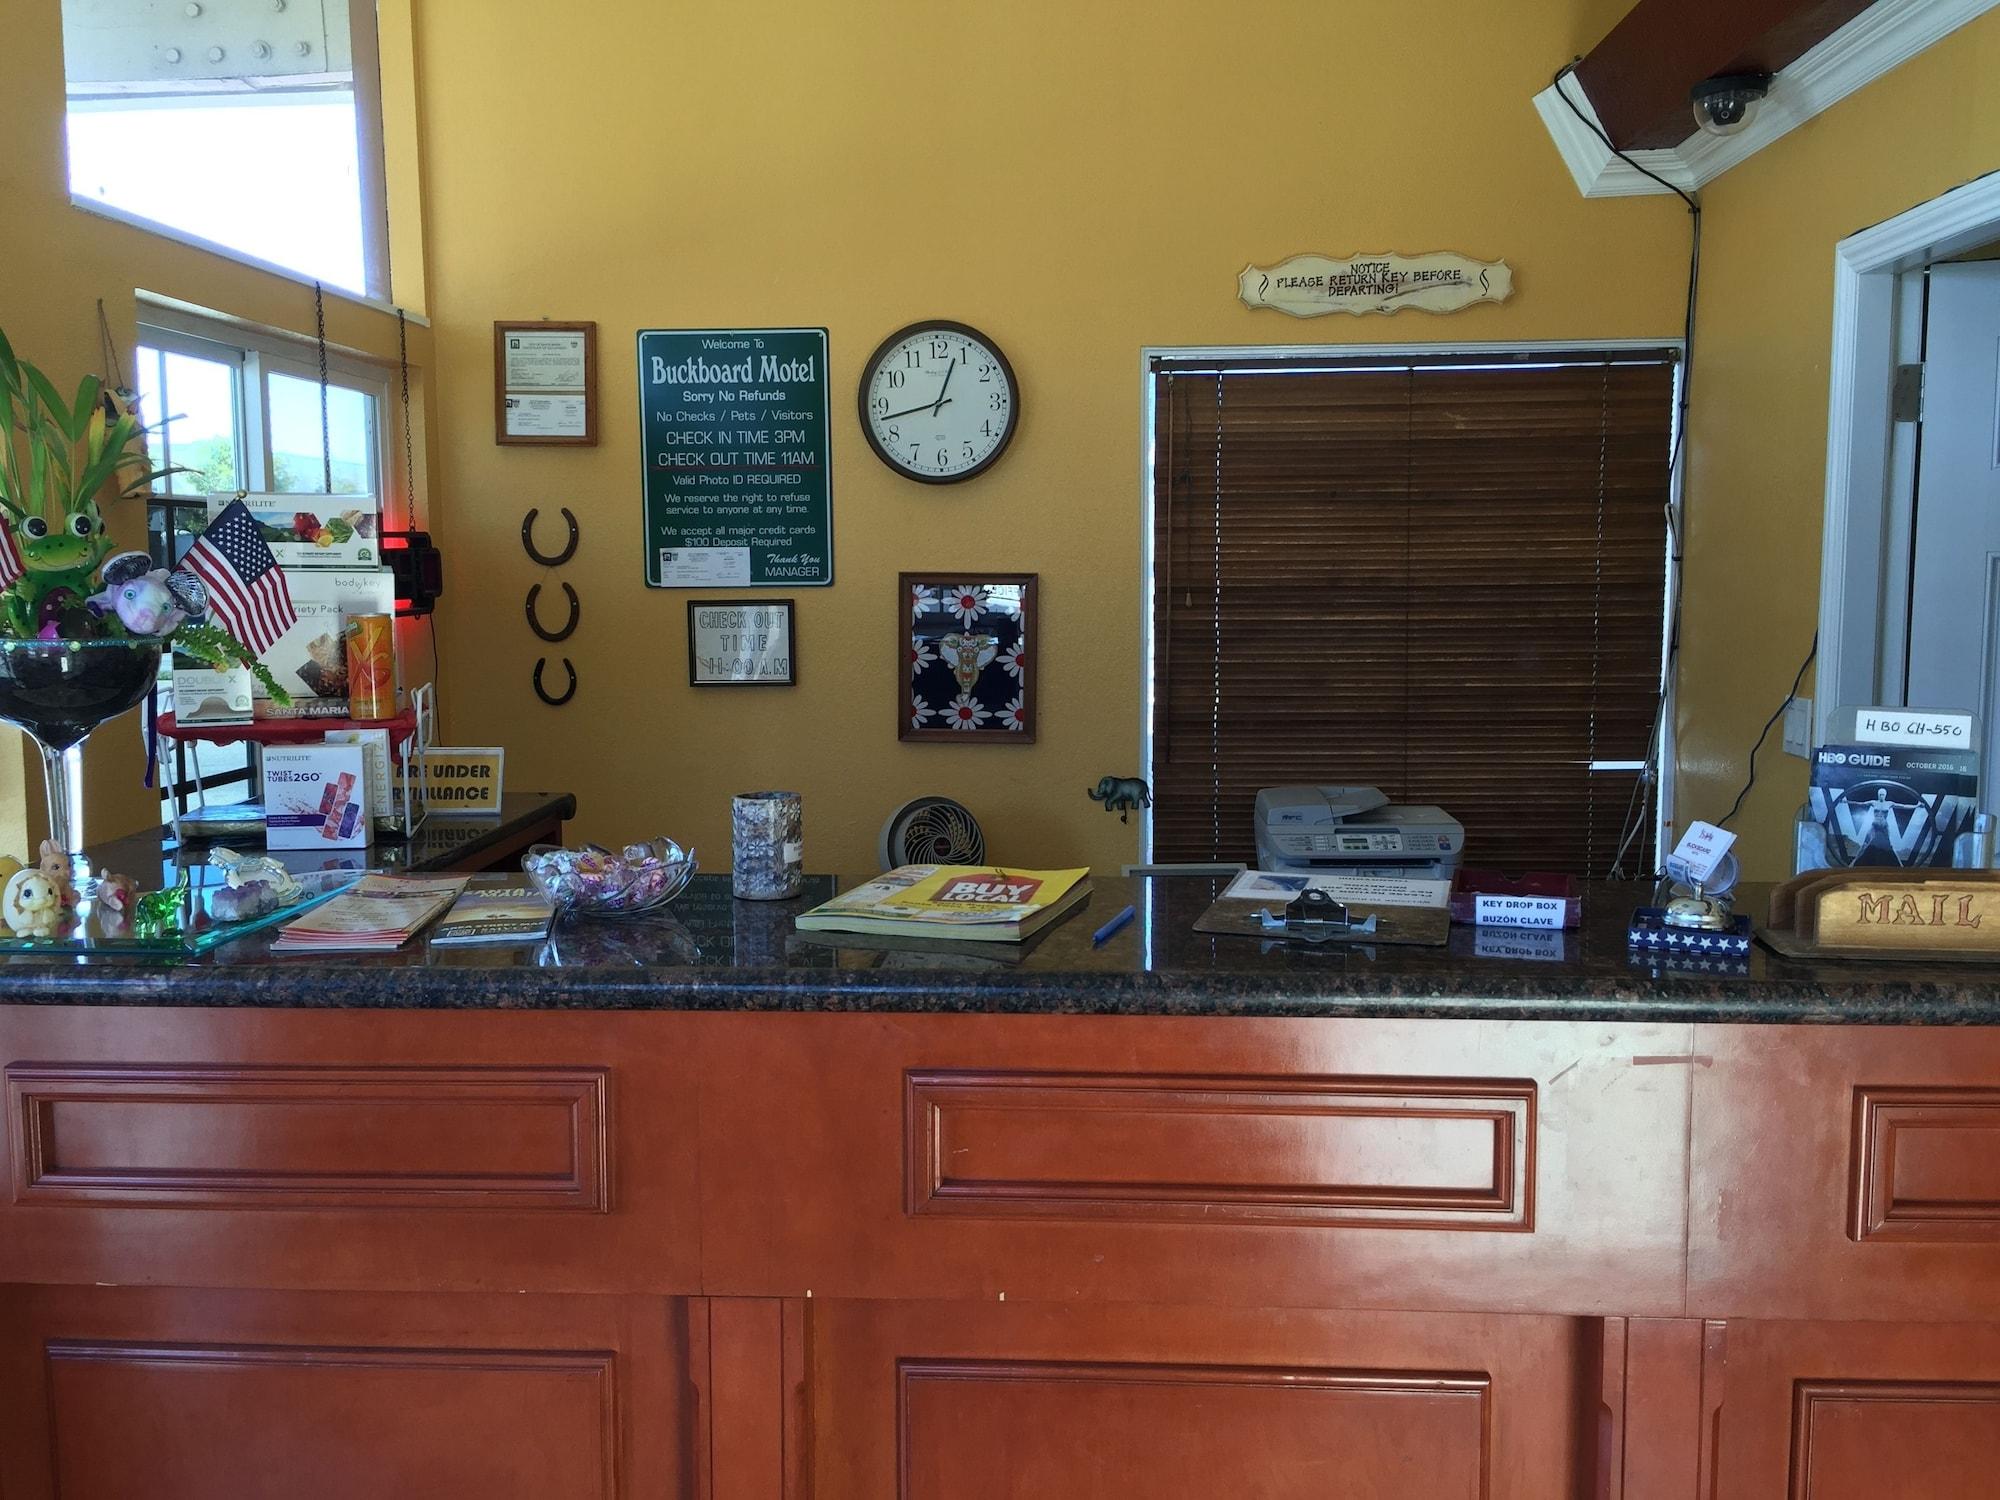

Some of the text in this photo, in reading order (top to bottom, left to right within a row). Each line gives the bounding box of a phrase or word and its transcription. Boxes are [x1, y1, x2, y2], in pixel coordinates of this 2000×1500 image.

[1350, 263, 1390, 273] NOTICE
[1277, 270, 1460, 288] PLEASE RETURN KEY BEFORE
[1328, 284, 1399, 296] DEPARTING!
[702, 339, 764, 349] Welcome To
[930, 341, 948, 359] 12
[906, 351, 920, 368] 11
[960, 348, 968, 365] 1
[652, 355, 815, 384] Buckboard Motel
[979, 365, 990, 382] 2
[888, 370, 904, 388] 10
[683, 390, 785, 403] Sorry No Refunds
[990, 393, 1000, 411] 3
[878, 397, 889, 415] 9
[657, 412, 672, 421] No
[676, 411, 715, 421] Checks
[731, 411, 756, 421] Pets
[771, 410, 813, 420] Visitors
[889, 425, 900, 442] 8
[980, 420, 992, 436] 4
[666, 430, 805, 444] CHECK IN TIME 3PM
[910, 443, 920, 461] 7
[962, 441, 973, 458] 5
[658, 452, 814, 466] CHECK OUT TIME 11AM
[937, 448, 948, 466] 6
[672, 474, 801, 485] Valid Photo ID REQUIRED
[225, 500, 273, 508] NRILITE
[664, 494, 680, 503] We
[684, 495, 719, 503] reserve
[723, 494, 737, 502] the
[741, 493, 763, 504] right
[780, 494, 810, 502] refuse
[666, 505, 809, 516] service to anyone at any time.
[661, 526, 816, 536] We accept all major credit cards
[685, 537, 792, 547] $100 Deposit Required
[767, 553, 821, 565] Thank You
[765, 567, 820, 576] MANAGER
[294, 604, 343, 615] riety Pack
[699, 611, 784, 629] CHECK OUT
[720, 635, 767, 651] TIME
[710, 657, 754, 675] 11:00
[266, 706, 350, 717] SANTA MARIA
[1907, 721, 1962, 736] CH-550
[1818, 752, 1891, 767] HBO GUIDE
[1906, 762, 1937, 770] OCTOBER
[434, 765, 490, 778] UNDER
[942, 882, 1034, 903] BUY LOCAL
[1506, 901, 1533, 909] DROP
[1537, 902, 1557, 910] BOX
[1857, 893, 1982, 928] MAIL
[1482, 915, 1553, 925] BUZÓN CLAVE
